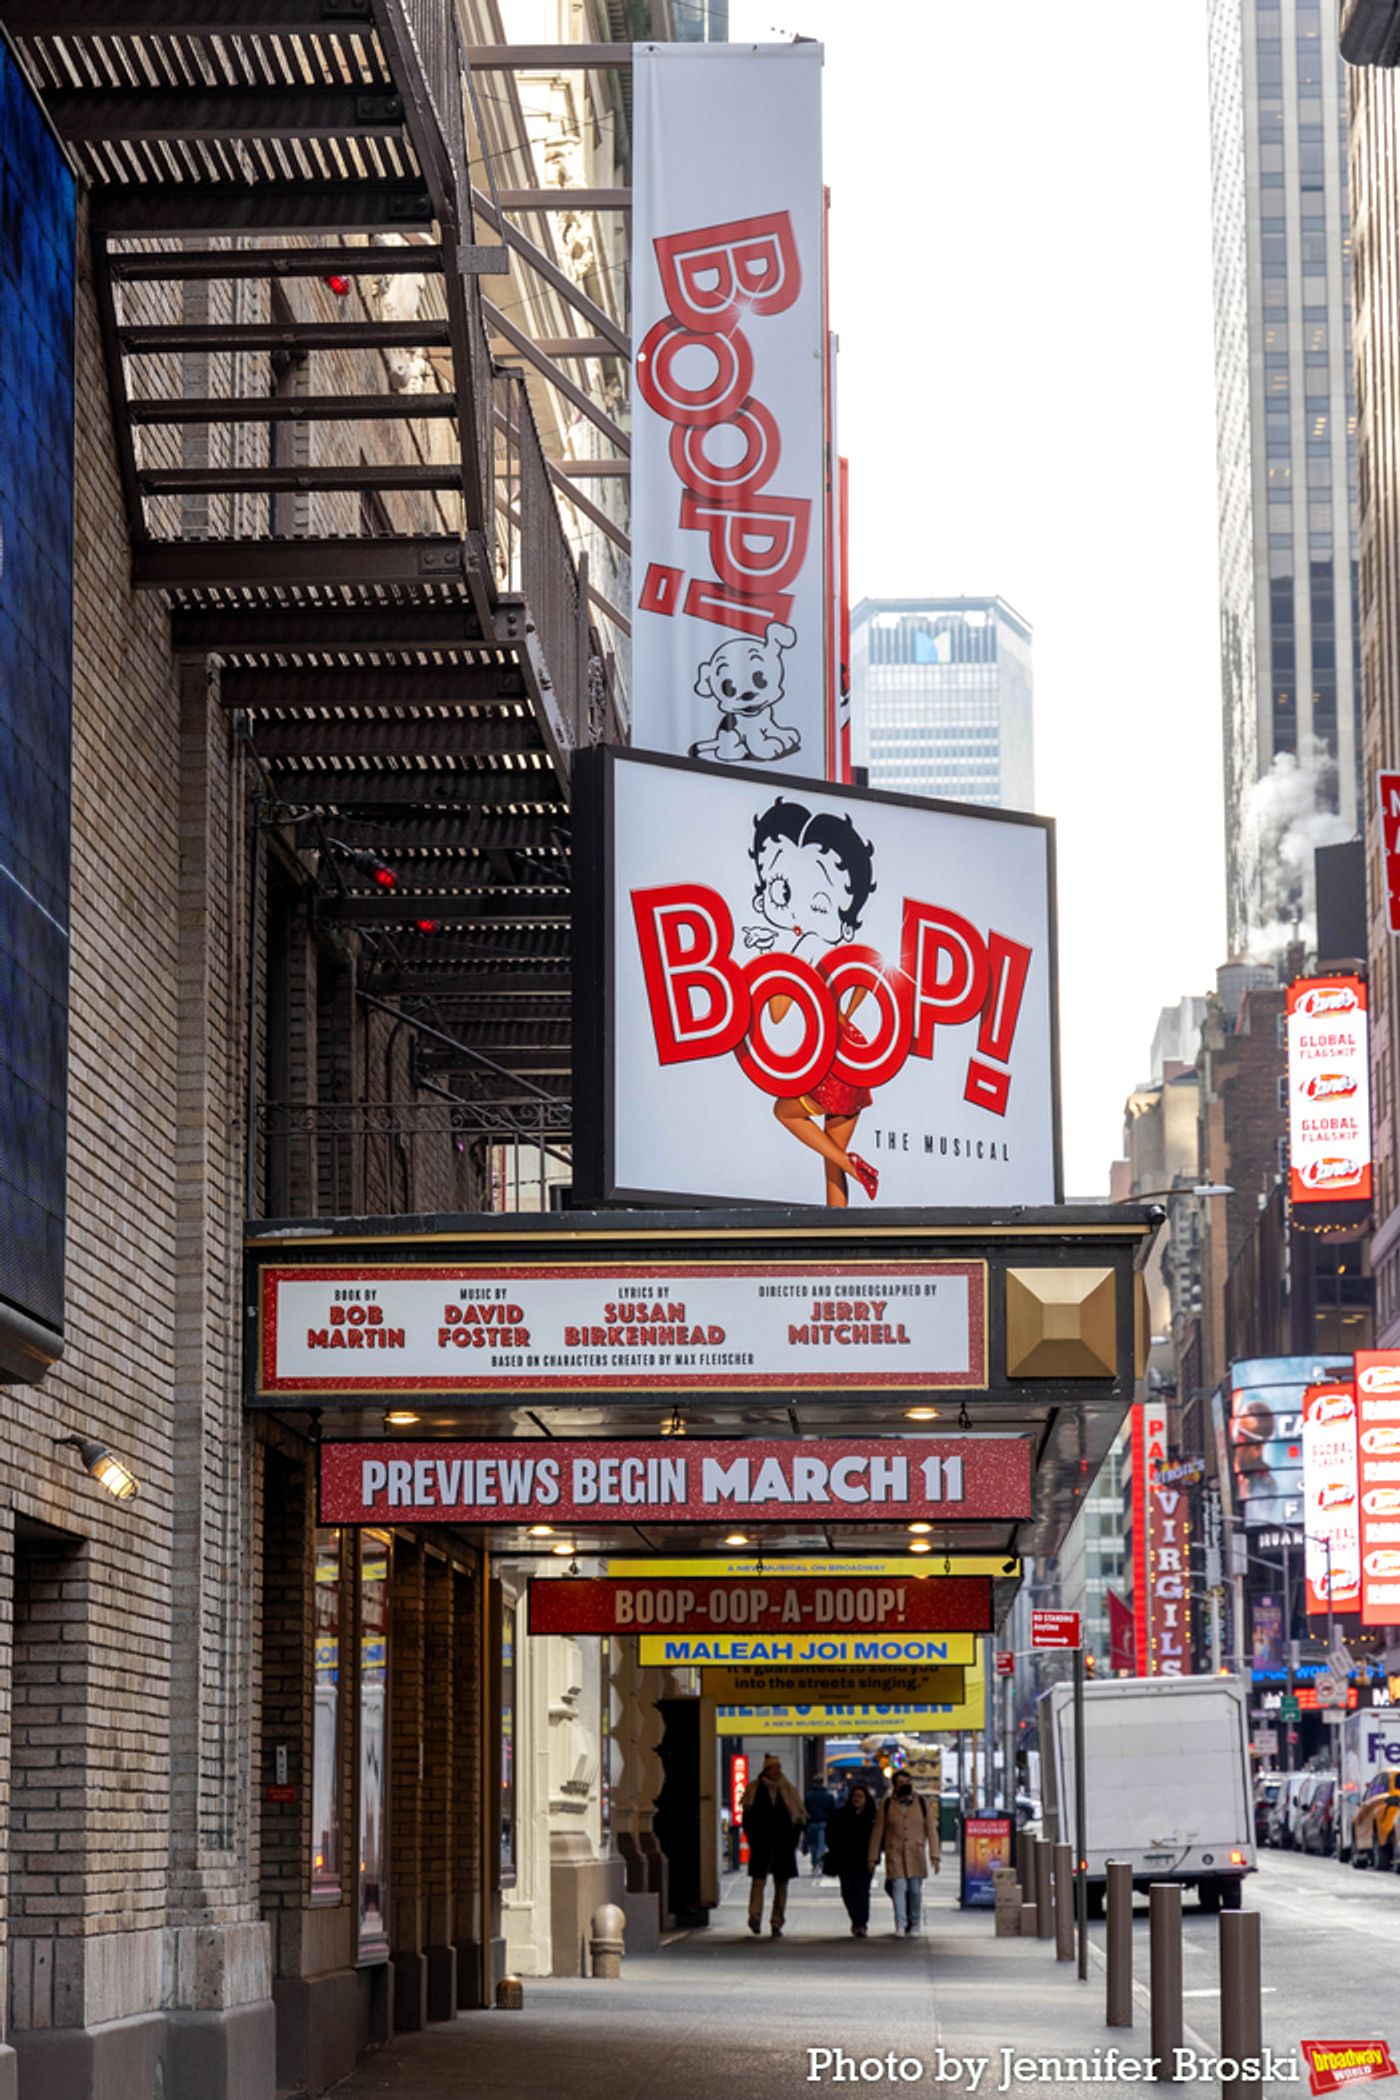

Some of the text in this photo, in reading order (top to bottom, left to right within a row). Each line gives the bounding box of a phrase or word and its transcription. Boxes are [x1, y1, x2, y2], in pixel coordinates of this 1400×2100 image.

[635, 210, 812, 637] BOOP!
[630, 883, 1032, 1117] BOOP!
[1300, 1034, 1356, 1047] GLOBAL
[1300, 1047, 1356, 1059] FLAGSHIP
[1302, 1117, 1359, 1131] GLOBAL
[1302, 1131, 1359, 1143] FLAGSHIP
[875, 1129, 1010, 1162] THE MUSICAL
[334, 1289, 377, 1301] BOOK BY
[459, 1288, 507, 1300] MUSIC BY
[618, 1287, 669, 1299] LYRICS BY
[758, 1284, 937, 1297] DIRECTED AND CHOREOGRAPHED BY
[329, 1305, 384, 1326] BOB
[444, 1304, 524, 1325] DAVID
[603, 1302, 686, 1323] SUSAN
[810, 1301, 888, 1322] JERRY
[307, 1328, 406, 1349] MARTIN
[437, 1327, 531, 1348] FOSTER
[564, 1325, 726, 1347] BIRKENHEAD
[788, 1324, 911, 1345] MITCHELL
[491, 1353, 754, 1367] BASED ON CHARACTERS CREATED BY MAX FLEISCHER
[361, 1455, 965, 1506] PREVIEWS BEGIN MARCH 11
[811, 1564, 827, 1572] ON
[829, 1564, 886, 1572] BROADWAY
[615, 1588, 906, 1624] BOOP-OOP-A-DOOP!
[1033, 1613, 1075, 1624] NO STANDING
[1034, 1623, 1060, 1632] Anytime
[665, 1641, 948, 1660] MALEAH JOI MOON
[735, 1677, 765, 1690] into
[769, 1677, 794, 1690] the
[798, 1677, 855, 1690] streets
[838, 1719, 852, 1727] ON
[854, 1718, 905, 1726] BROADWAY
